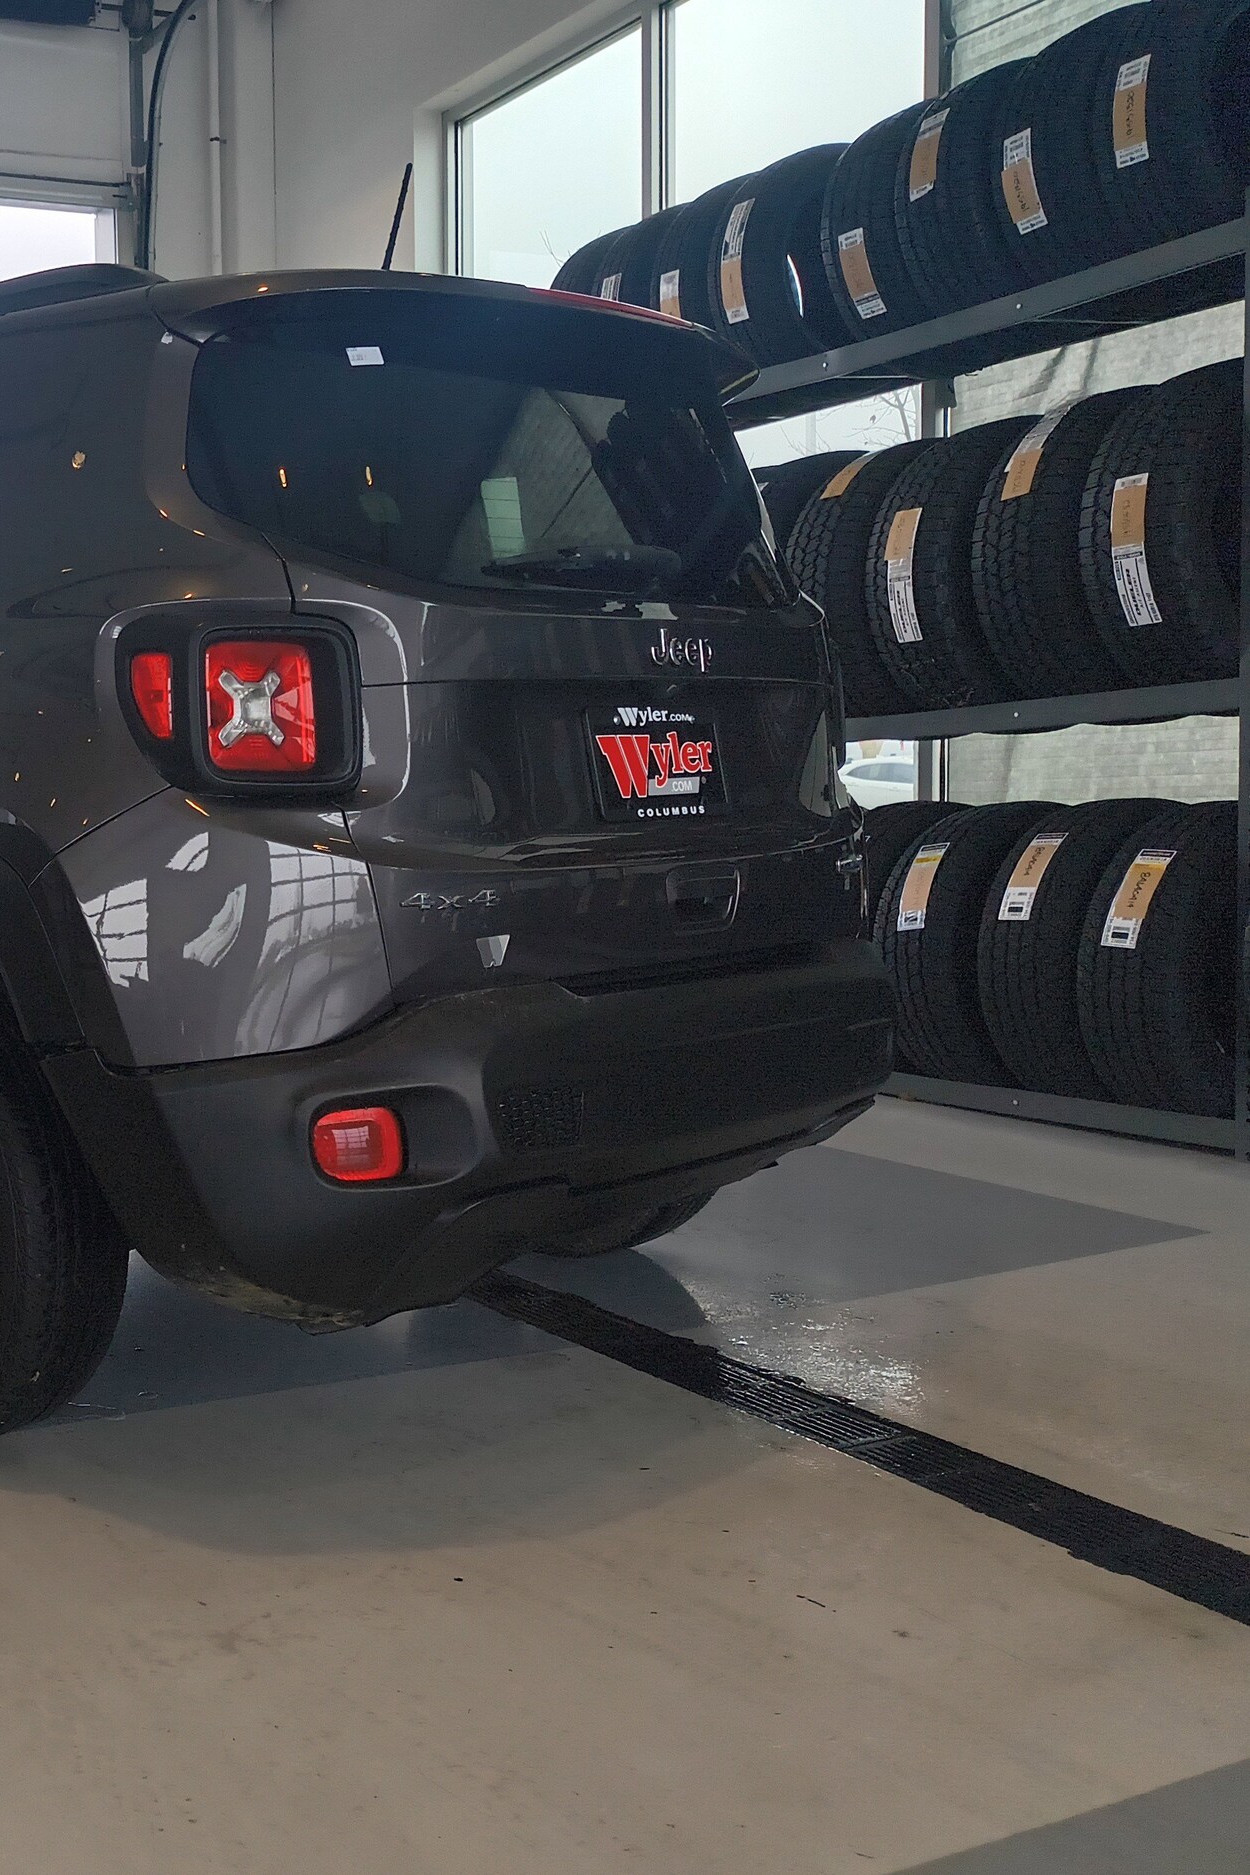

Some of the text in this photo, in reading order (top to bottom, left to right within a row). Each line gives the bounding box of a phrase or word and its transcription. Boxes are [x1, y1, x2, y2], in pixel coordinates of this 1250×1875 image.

[651, 628, 713, 673] Jeep
[596, 731, 713, 799] Wyler
[637, 805, 706, 818] COLUMBUS
